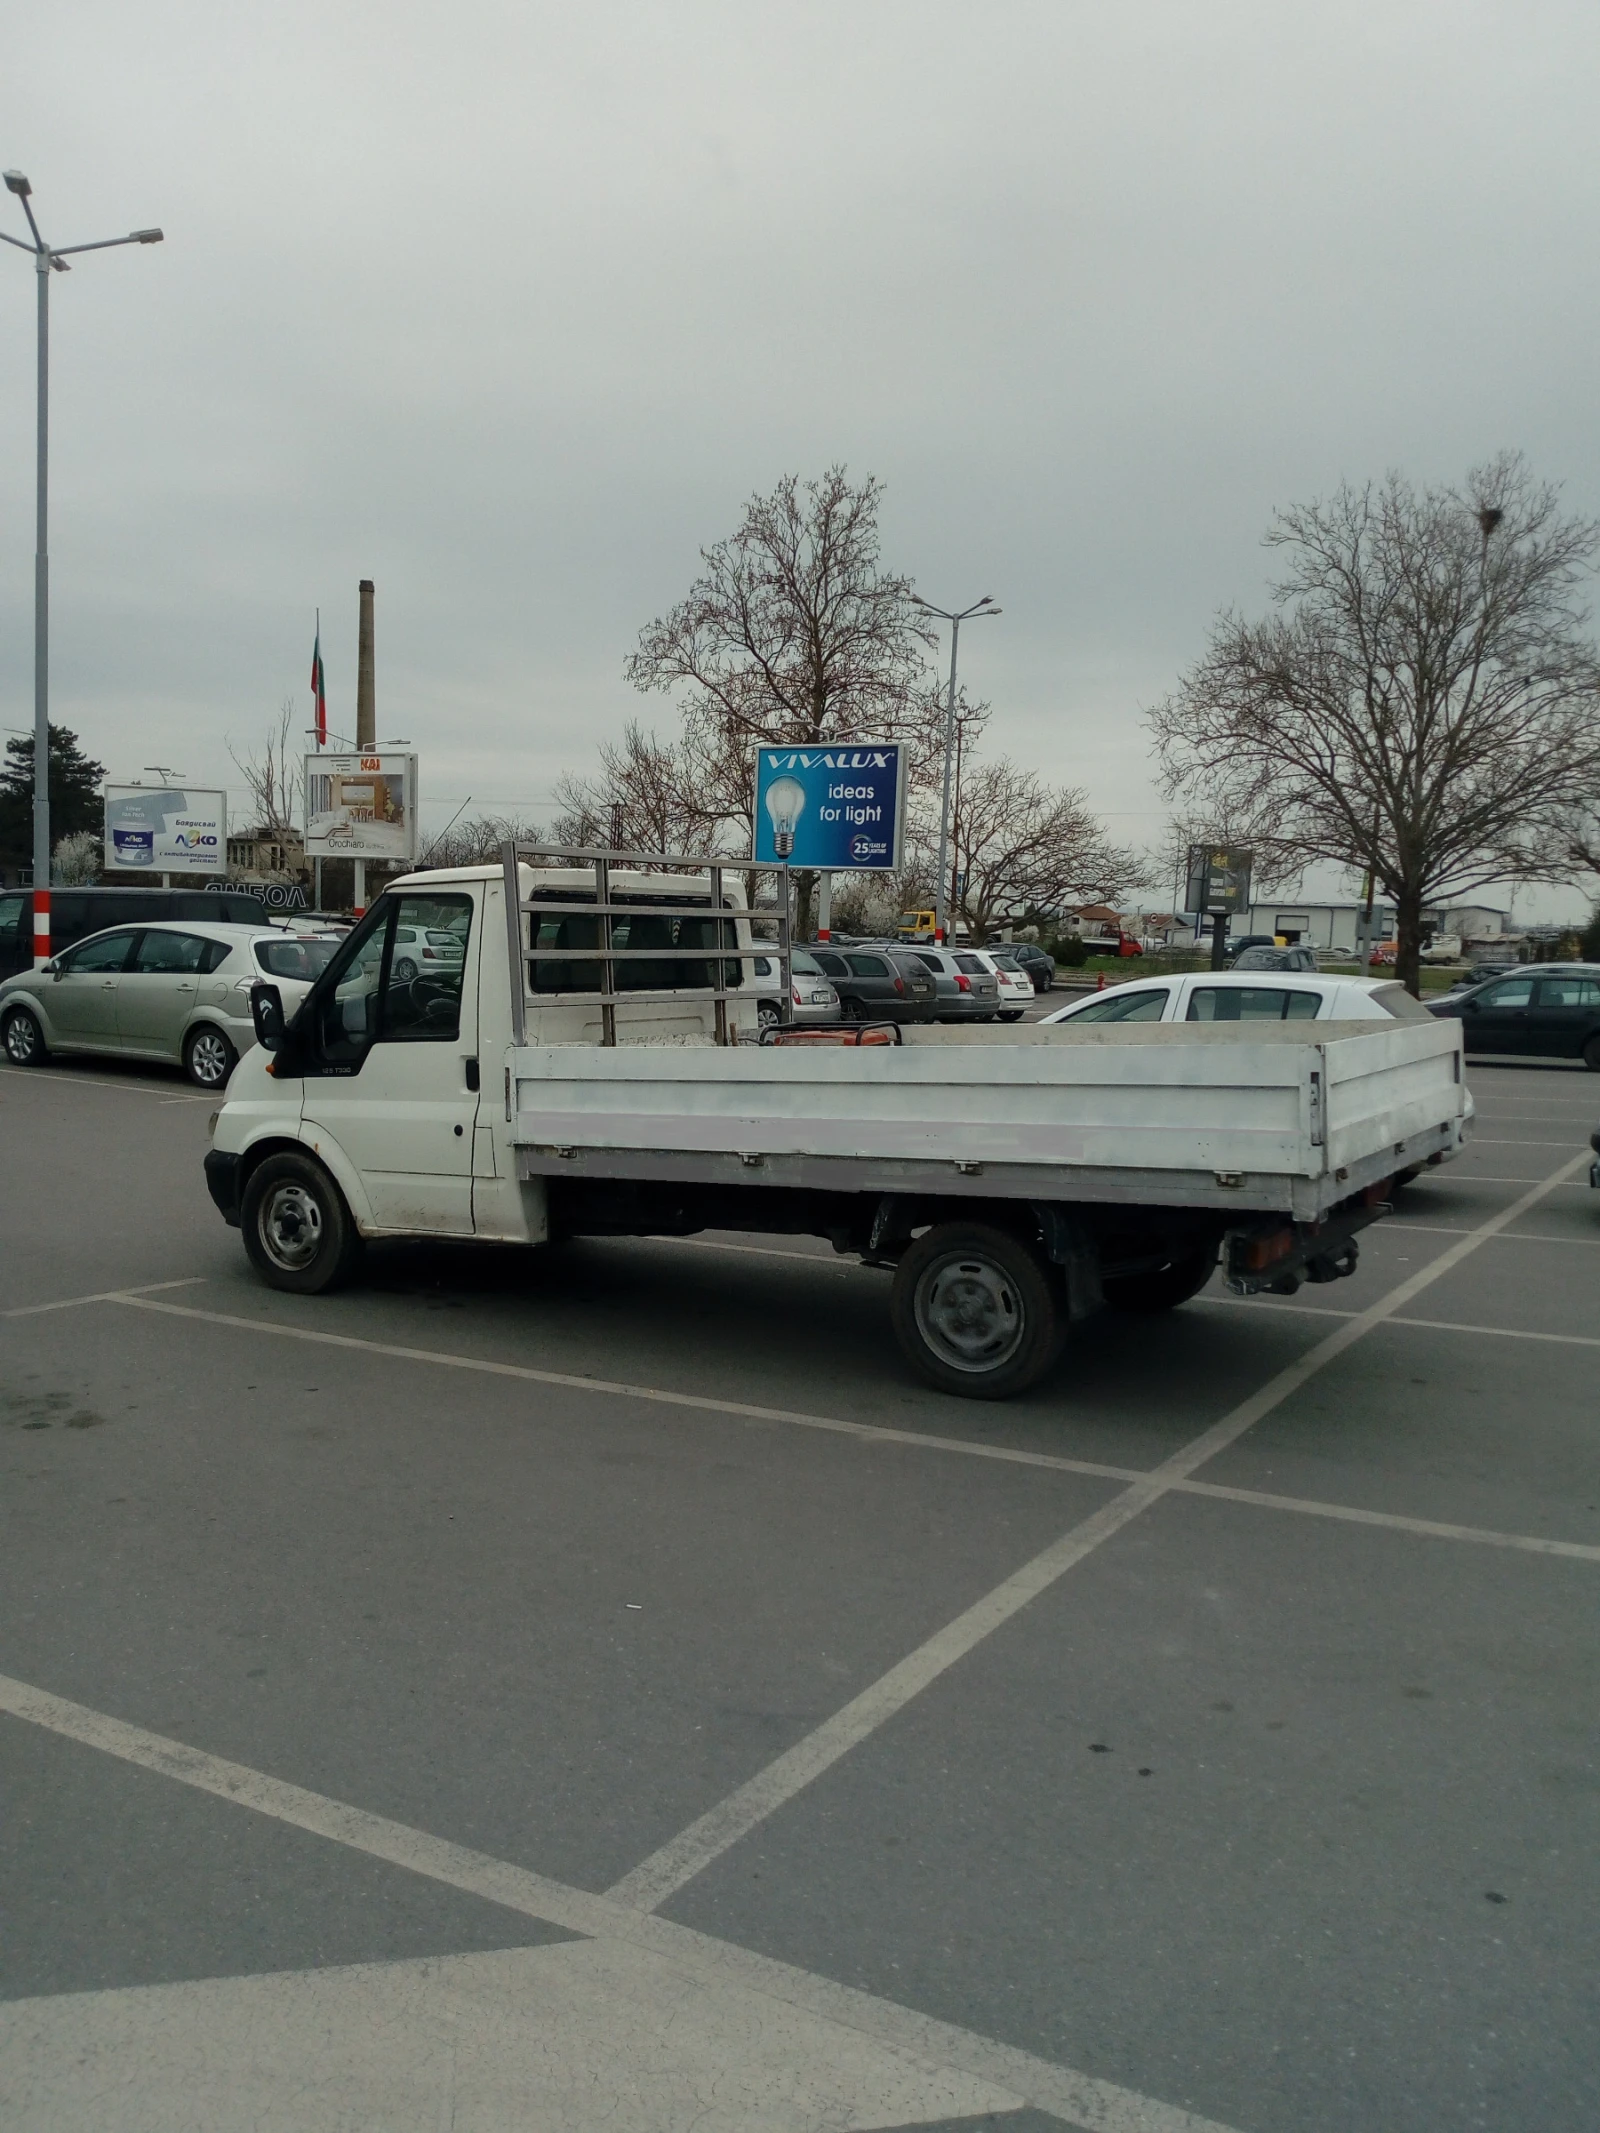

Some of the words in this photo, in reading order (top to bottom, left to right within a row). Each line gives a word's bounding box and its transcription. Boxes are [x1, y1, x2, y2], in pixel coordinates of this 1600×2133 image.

[828, 783, 875, 799] ideas
[819, 805, 842, 821] for
[845, 805, 882, 825] light
[853, 842, 869, 854] 25
